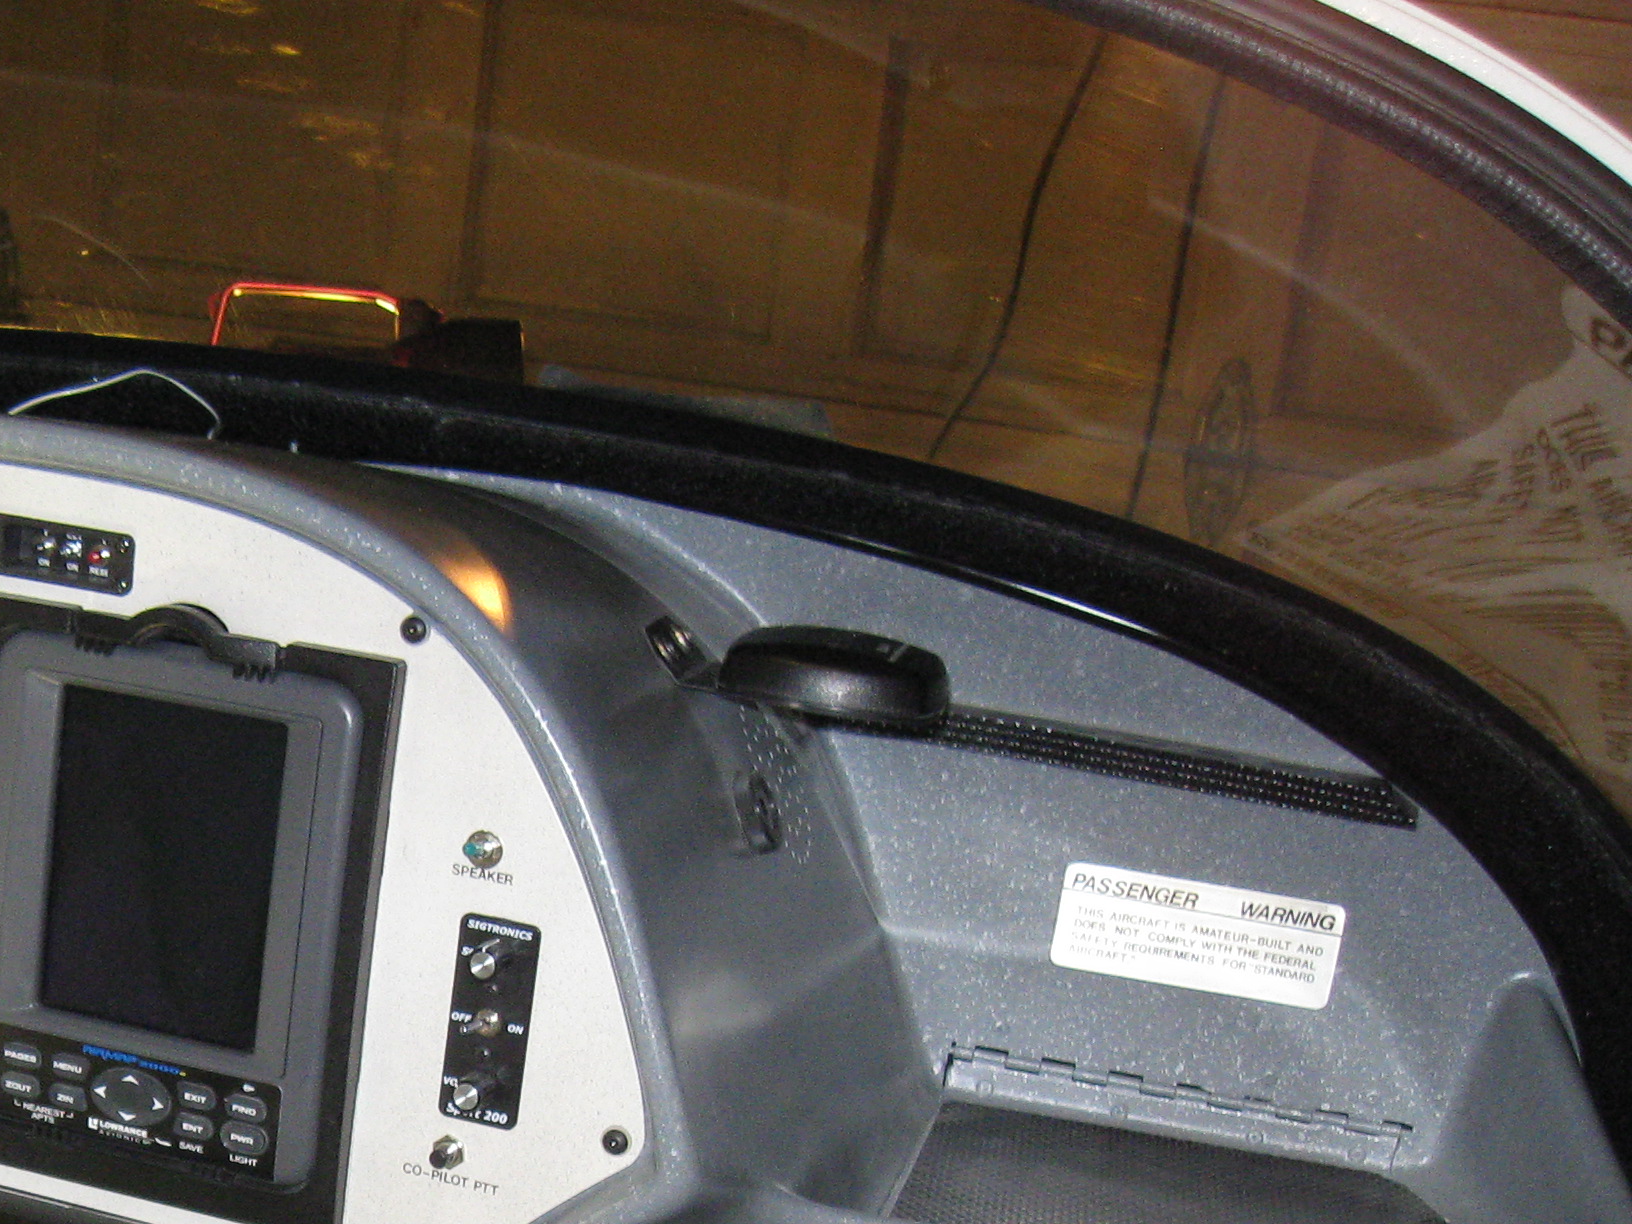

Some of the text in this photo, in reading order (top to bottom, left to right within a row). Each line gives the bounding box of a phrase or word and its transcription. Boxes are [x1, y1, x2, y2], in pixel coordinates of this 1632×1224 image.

[452, 863, 514, 886] SPEAKER
[1072, 872, 1336, 932] PASSENGER WARNING
[467, 918, 534, 942] SIGTRONICS
[1076, 906, 1324, 957] THIS AIRCRAFT IS AMATEUR-BUILT AND
[1071, 932, 1119, 948] SAFETY
[1124, 942, 1215, 966] REQUIREMENTS
[1222, 958, 1247, 971] FOR
[1074, 918, 1316, 971] DOES NOT COMPLY WITH THE FEDERAL
[451, 1010, 472, 1024] OFF
[507, 1022, 524, 1035] ON
[4, 1049, 37, 1064] PAGES
[53, 1060, 82, 1075] MENU
[4, 1079, 32, 1093] ZOUT
[56, 1092, 74, 1105] ZIN
[184, 1092, 207, 1105] EXIT
[22, 1101, 66, 1118] NEAREST
[231, 1104, 257, 1117] FIND
[483, 1109, 509, 1125] 200
[30, 1111, 55, 1125] APTS
[99, 1119, 148, 1139] LOWRANCE
[182, 1122, 204, 1135] ENT
[230, 1132, 254, 1146] PWR
[179, 1141, 205, 1155] SAVE
[229, 1154, 258, 1167] LIGHT
[402, 1162, 500, 1196] CO-PILOT PTT
